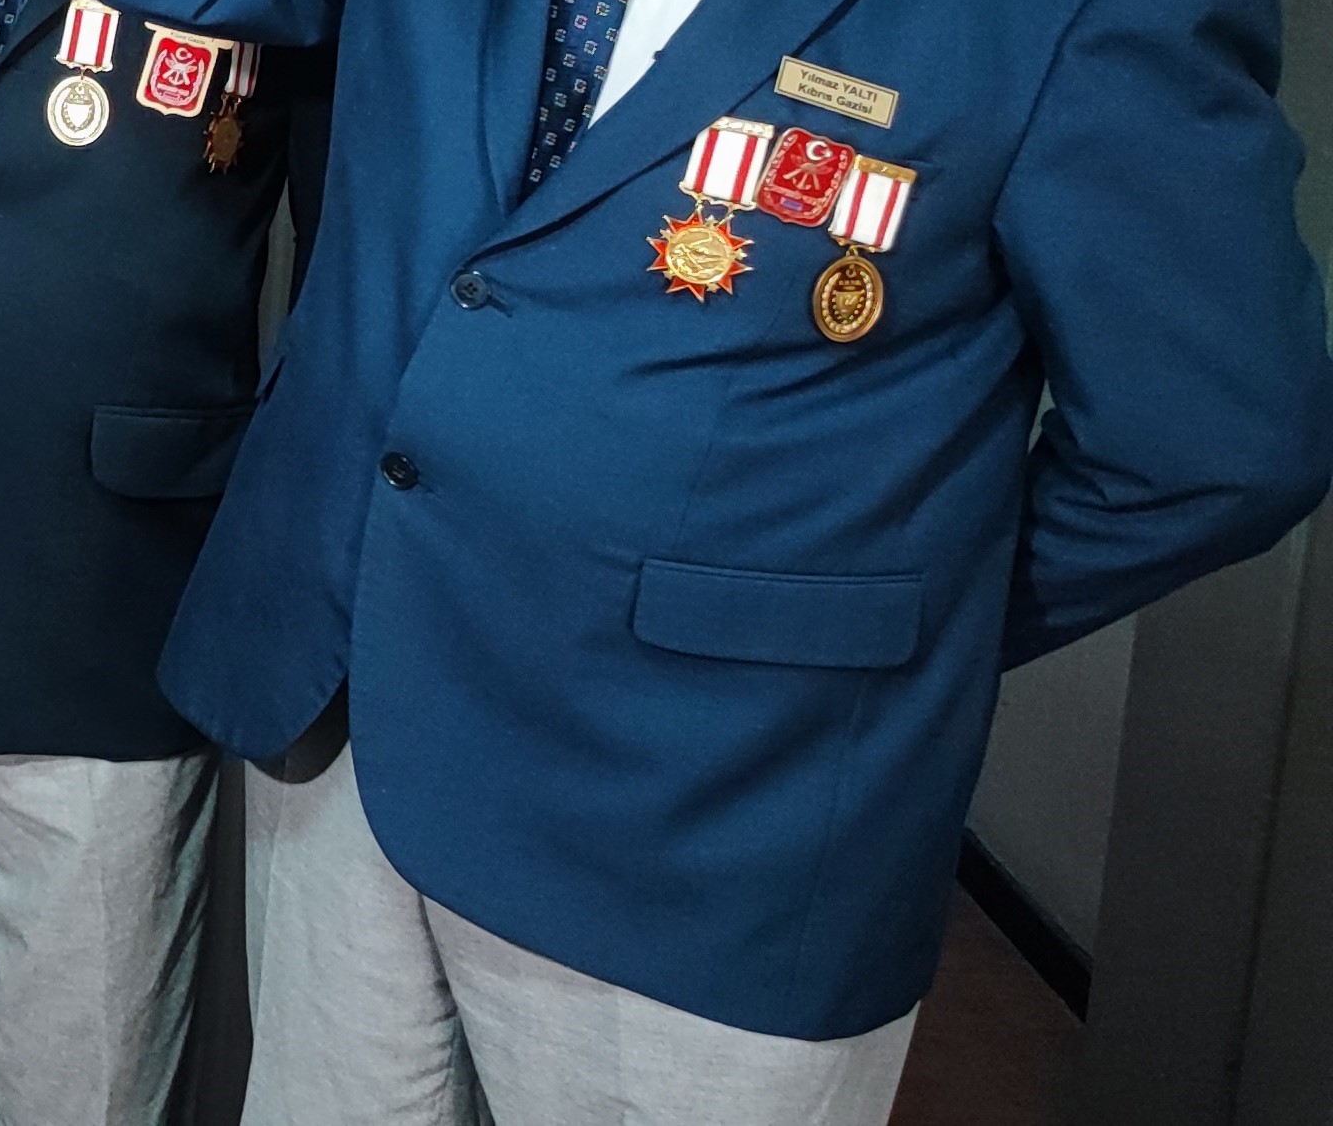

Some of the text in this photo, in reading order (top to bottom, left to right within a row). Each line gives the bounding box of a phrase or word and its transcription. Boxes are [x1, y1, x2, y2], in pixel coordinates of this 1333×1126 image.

[797, 82, 833, 102] Kıbrıs
[800, 69, 878, 103] Yılmaz YALTI
